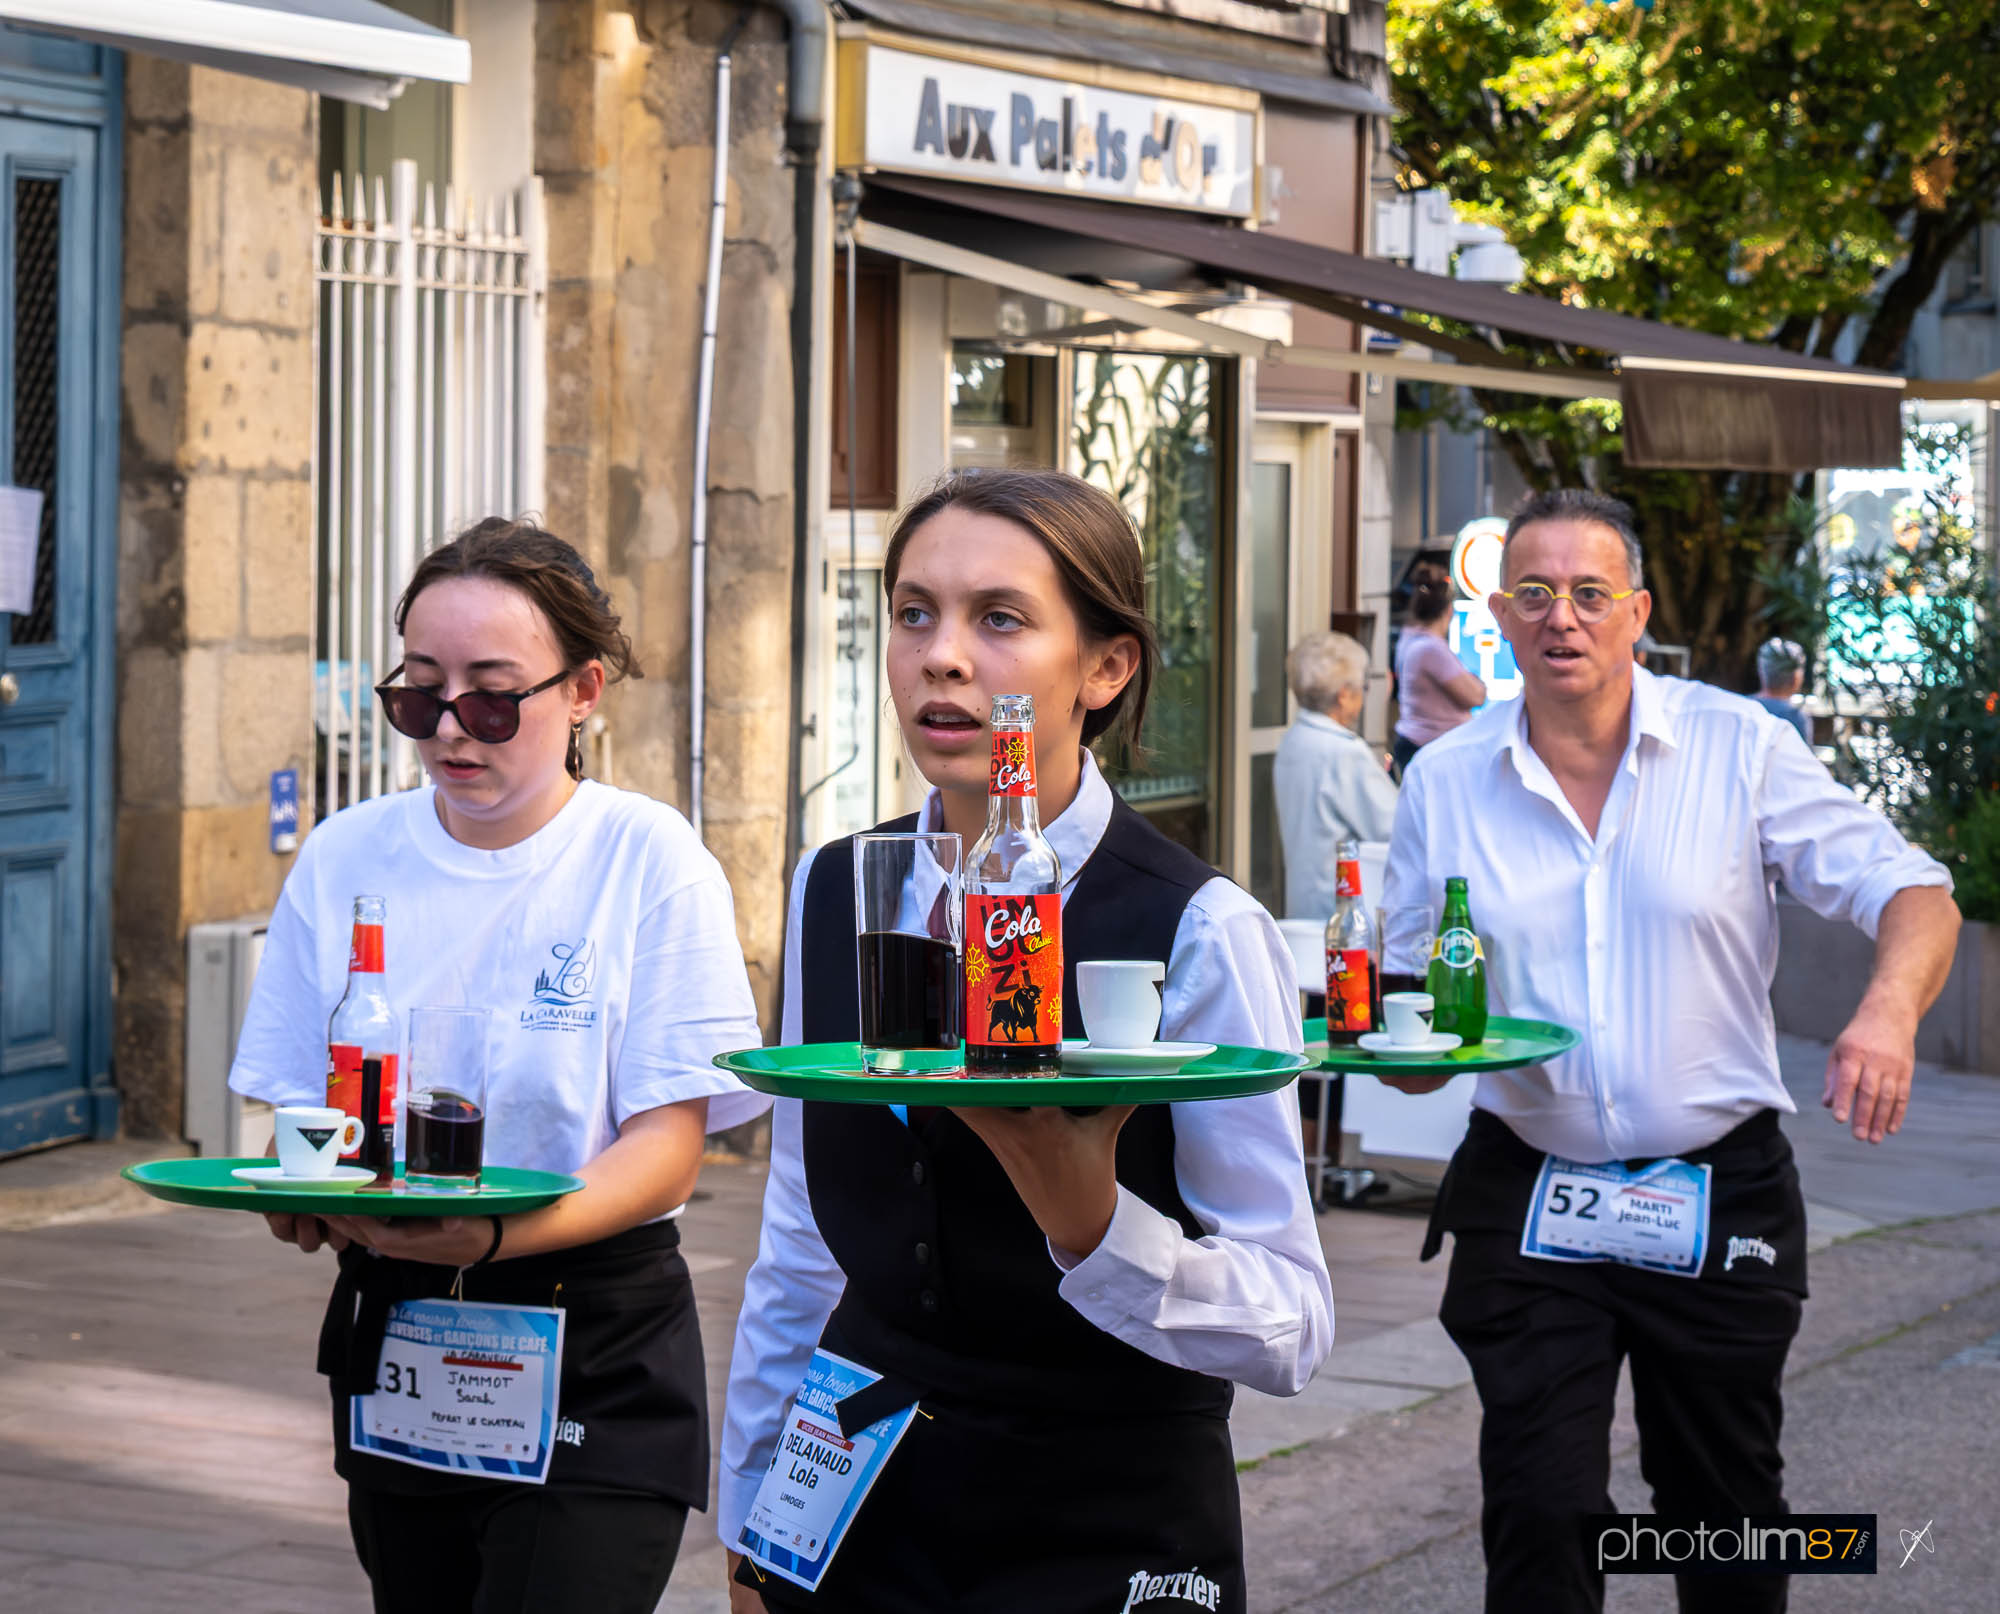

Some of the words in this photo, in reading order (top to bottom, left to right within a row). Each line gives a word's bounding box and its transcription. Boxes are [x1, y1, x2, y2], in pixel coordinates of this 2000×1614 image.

[914, 77, 998, 163] Aux
[1010, 91, 1128, 183] Palets
[997, 762, 1031, 790] Cola
[985, 905, 1042, 949] Cola
[520, 1010, 534, 1022] LA
[536, 1008, 597, 1021] CARAVELLE
[1548, 1184, 1600, 1221] 52
[1630, 1198, 1672, 1216] MARTI
[1616, 1208, 1681, 1230] Jean-Luc
[375, 1361, 422, 1400] 31
[448, 1371, 513, 1388] JAMMOT
[456, 1389, 496, 1406] Sarah
[785, 1433, 853, 1476] DELANAUD
[788, 1460, 819, 1490] Lola
[780, 1491, 806, 1510] LIMOGES
